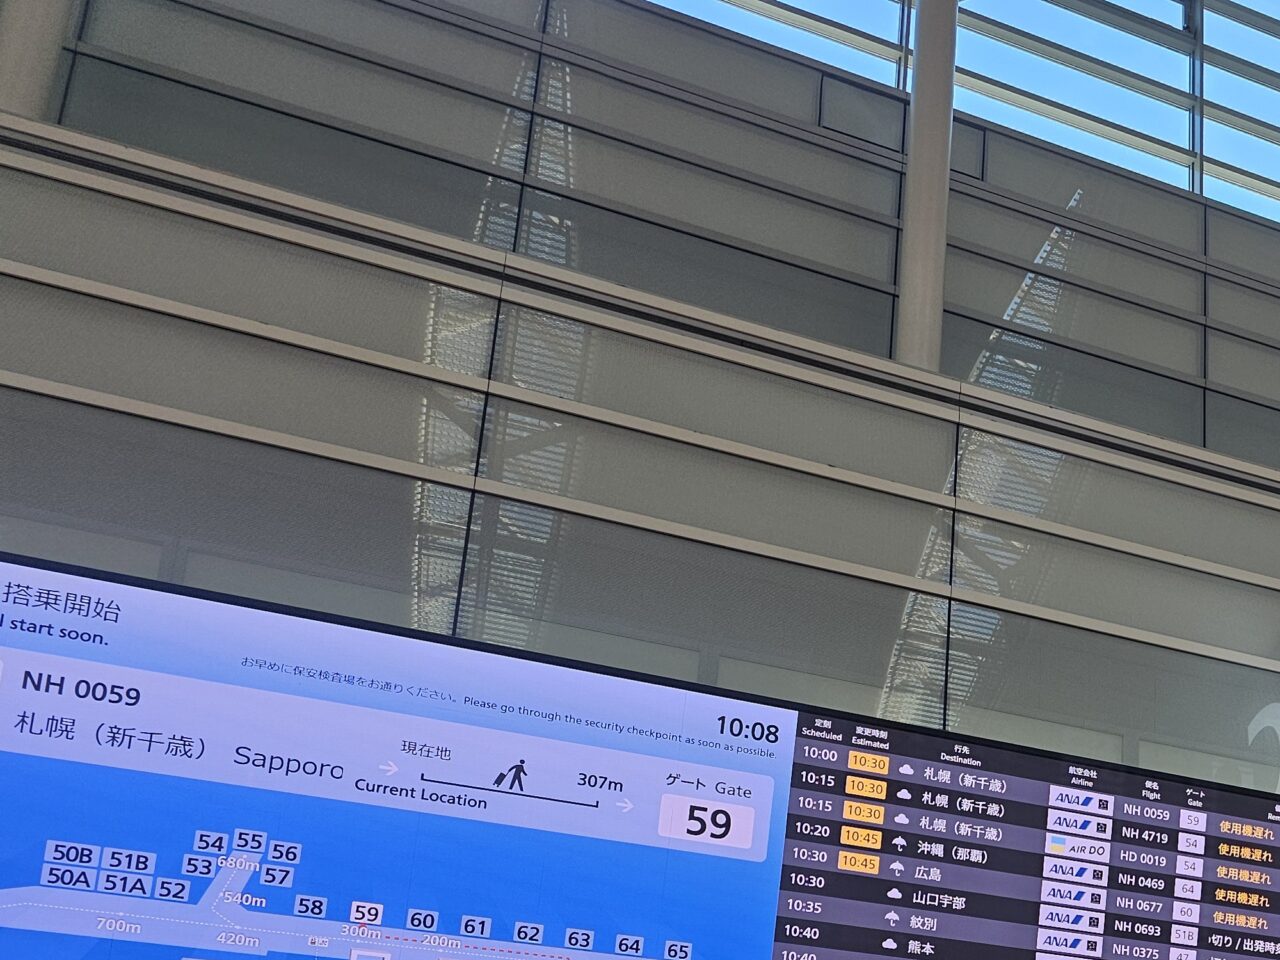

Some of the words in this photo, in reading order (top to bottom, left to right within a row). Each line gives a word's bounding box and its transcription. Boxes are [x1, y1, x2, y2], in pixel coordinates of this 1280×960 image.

[2, 582, 122, 624] 搭乗開始
[10, 616, 54, 637] start
[59, 627, 109, 646] soon.
[22, 670, 65, 696] NH
[75, 679, 141, 707] 0059
[464, 696, 498, 711] Please
[500, 703, 515, 715] go
[518, 706, 561, 722] through
[564, 714, 582, 725] the
[585, 717, 625, 734] security
[627, 724, 682, 743] checkpoint
[685, 736, 695, 745] as
[698, 738, 721, 749] soon
[723, 742, 734, 752] as
[736, 743, 777, 760] possible.
[717, 715, 779, 744] 10:08
[802, 727, 843, 741] Scheduled
[852, 736, 889, 750] Estimated
[401, 739, 451, 761] 現在地
[941, 752, 982, 767] Destination
[234, 746, 344, 781] Sapporo
[577, 772, 623, 792] 307m
[666, 772, 706, 790] ゲート
[715, 781, 752, 799] Gate
[1071, 776, 1094, 788] Airline
[354, 778, 416, 800] Current
[421, 788, 487, 810] Location
[803, 745, 838, 762] 10:00
[852, 754, 886, 770] 10:30
[1124, 803, 1141, 816] NH
[1143, 807, 1170, 821] 0059
[1187, 815, 1199, 825] 59
[1220, 820, 1275, 841] 使用機遅れ
[1142, 788, 1161, 800] Flight
[686, 804, 732, 839] 59
[197, 833, 224, 853] 54
[236, 831, 263, 850] 55
[798, 796, 832, 812] 10:15
[847, 804, 881, 820] 10:30
[1069, 845, 1086, 854] AIR
[1089, 846, 1105, 856] DO
[1120, 850, 1137, 862] HD
[1140, 854, 1166, 867] 0019
[1184, 861, 1196, 871] 54
[1216, 866, 1271, 886] 使用機遅れ
[53, 843, 93, 864] 50B
[109, 850, 149, 871] 51B
[271, 843, 298, 862] 56
[186, 857, 213, 876] 53
[217, 855, 260, 872] 680m
[47, 867, 91, 889] 50A
[103, 874, 147, 895] 51A
[264, 867, 290, 886] 57
[159, 880, 186, 900] 52
[223, 891, 266, 908] 540m
[297, 897, 324, 917] 58
[354, 905, 379, 922] 59
[96, 917, 141, 934] 700m
[410, 912, 435, 929] 60
[464, 919, 487, 936] 61
[216, 931, 259, 948] 420m
[340, 924, 381, 940] 300m
[421, 934, 462, 949] 200m
[517, 926, 540, 942] 62
[568, 932, 592, 948] 63
[618, 938, 641, 954] 64
[667, 944, 689, 960] 65
